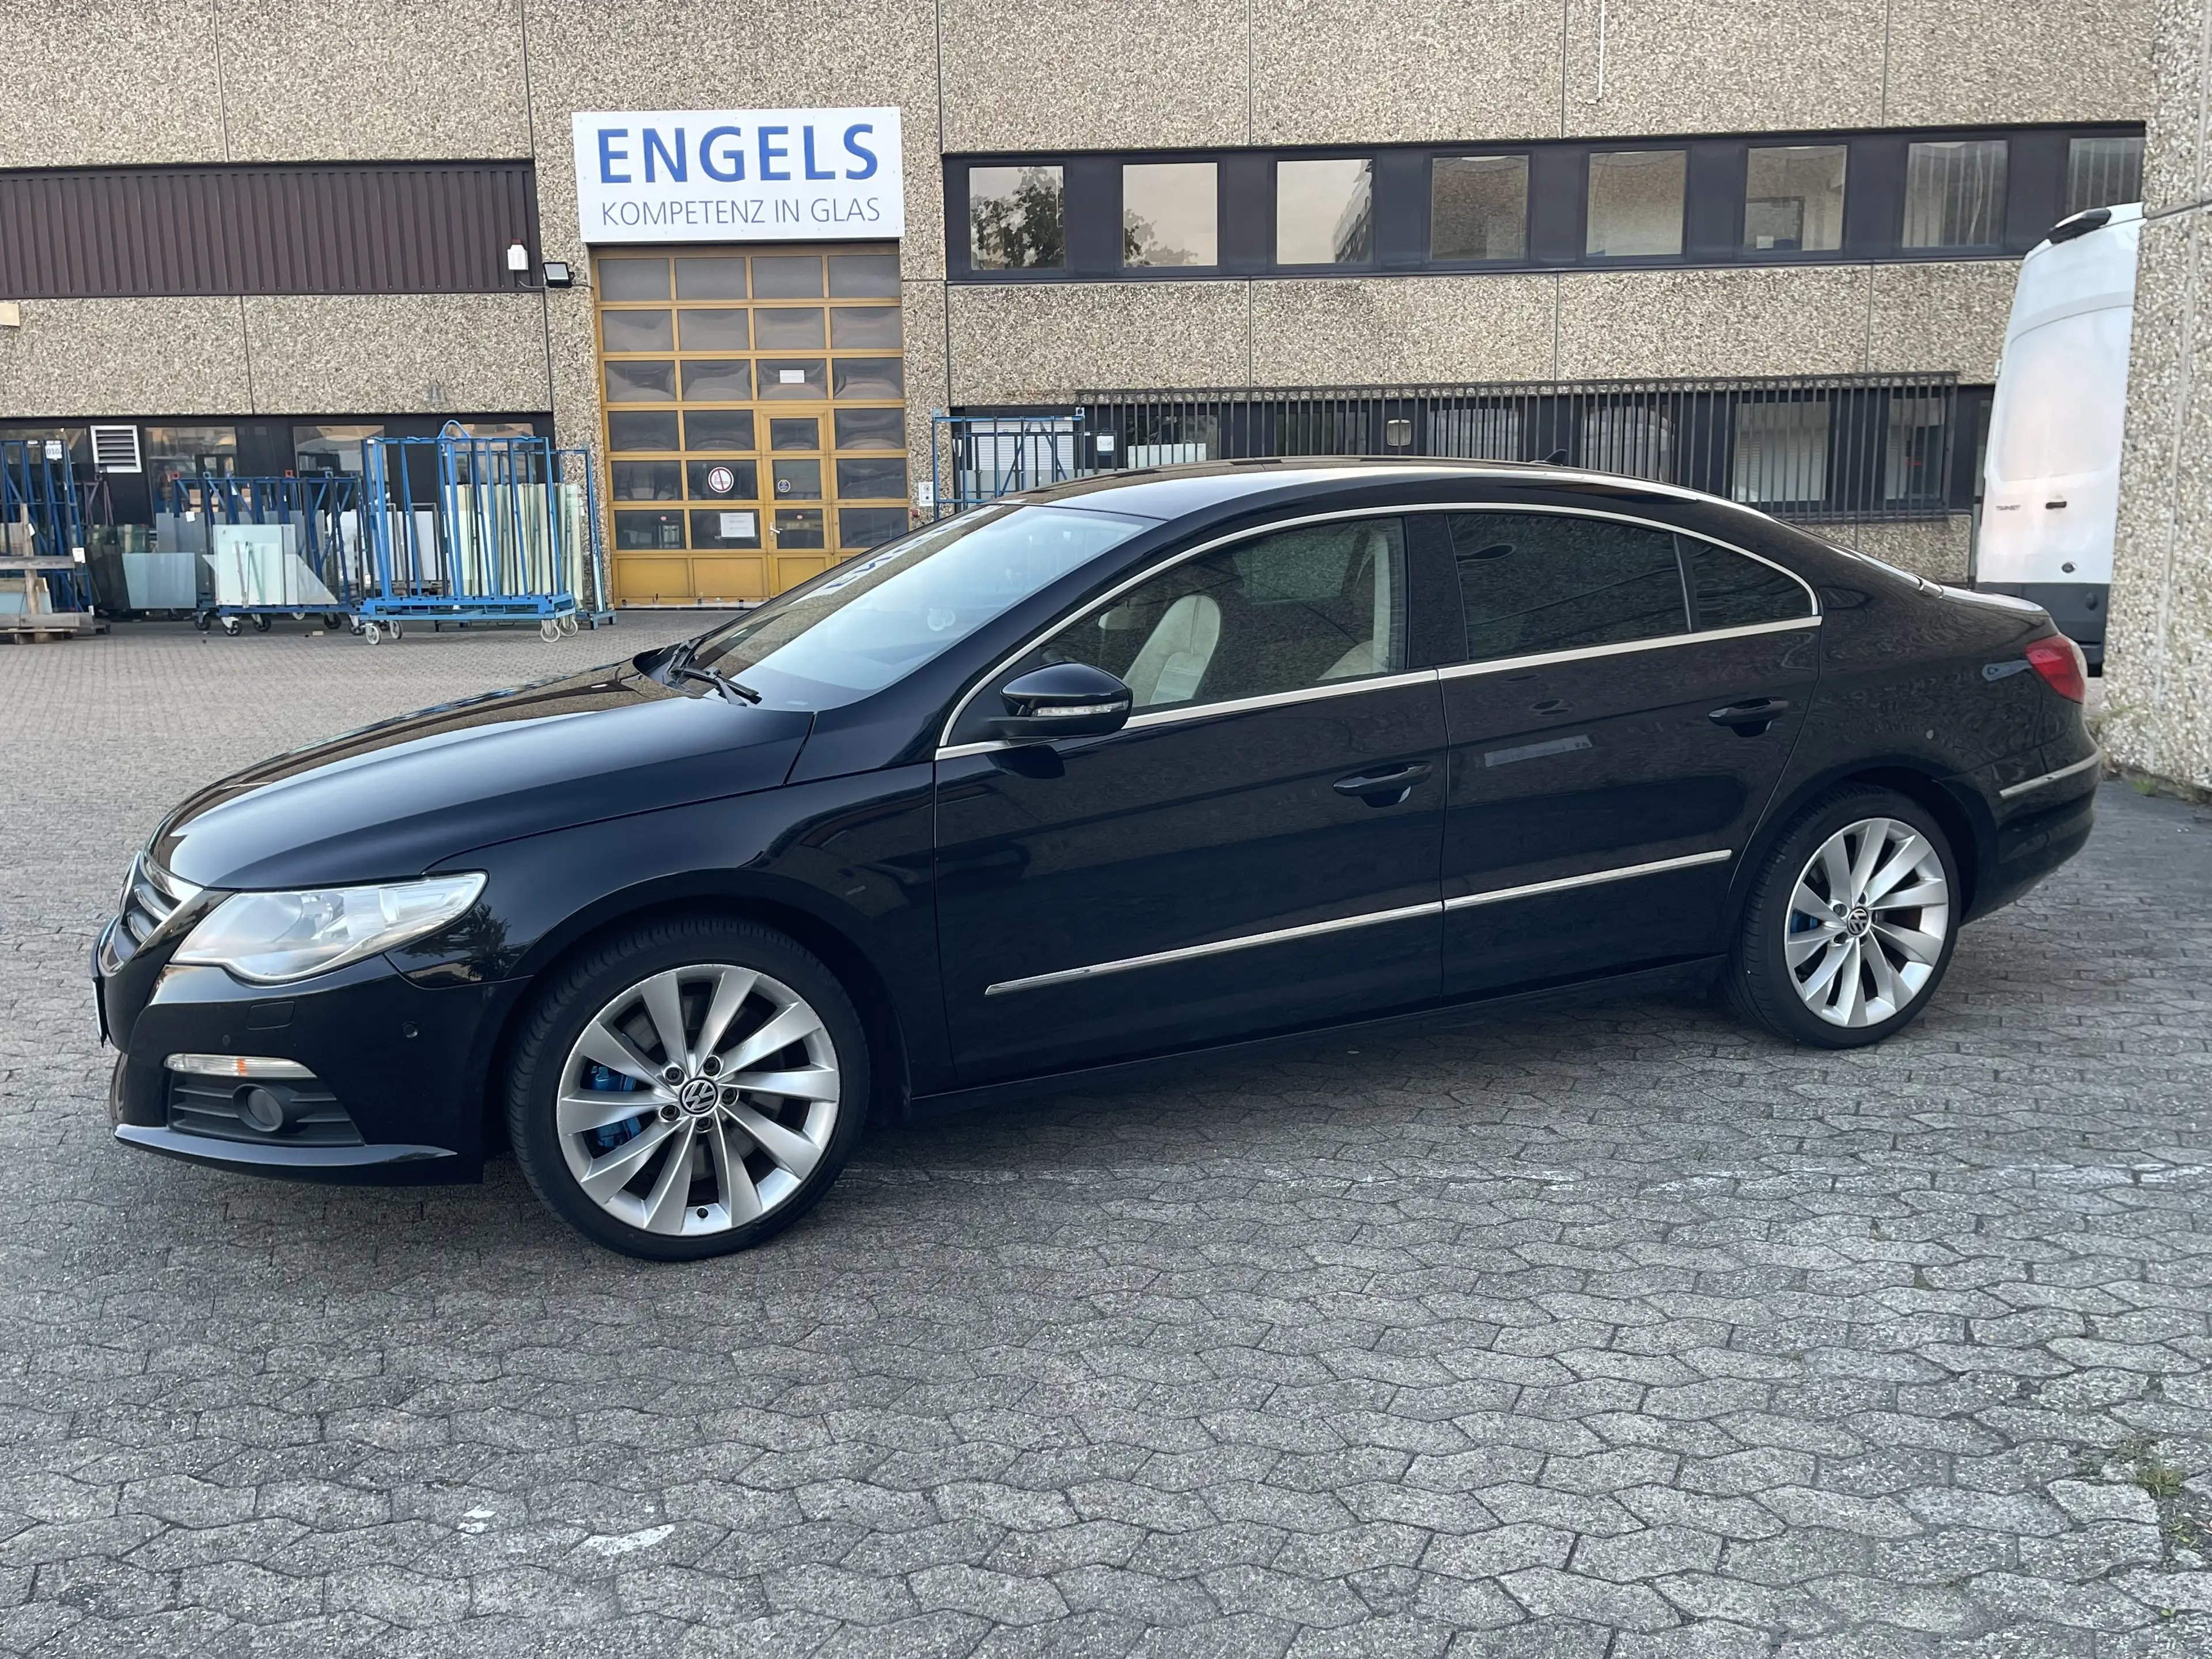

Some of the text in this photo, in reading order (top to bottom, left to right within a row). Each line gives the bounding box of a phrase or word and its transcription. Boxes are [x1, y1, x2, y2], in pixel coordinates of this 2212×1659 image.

[597, 123, 878, 184] ENGELS
[602, 197, 880, 226] KOMPETENZ IN GLAS
